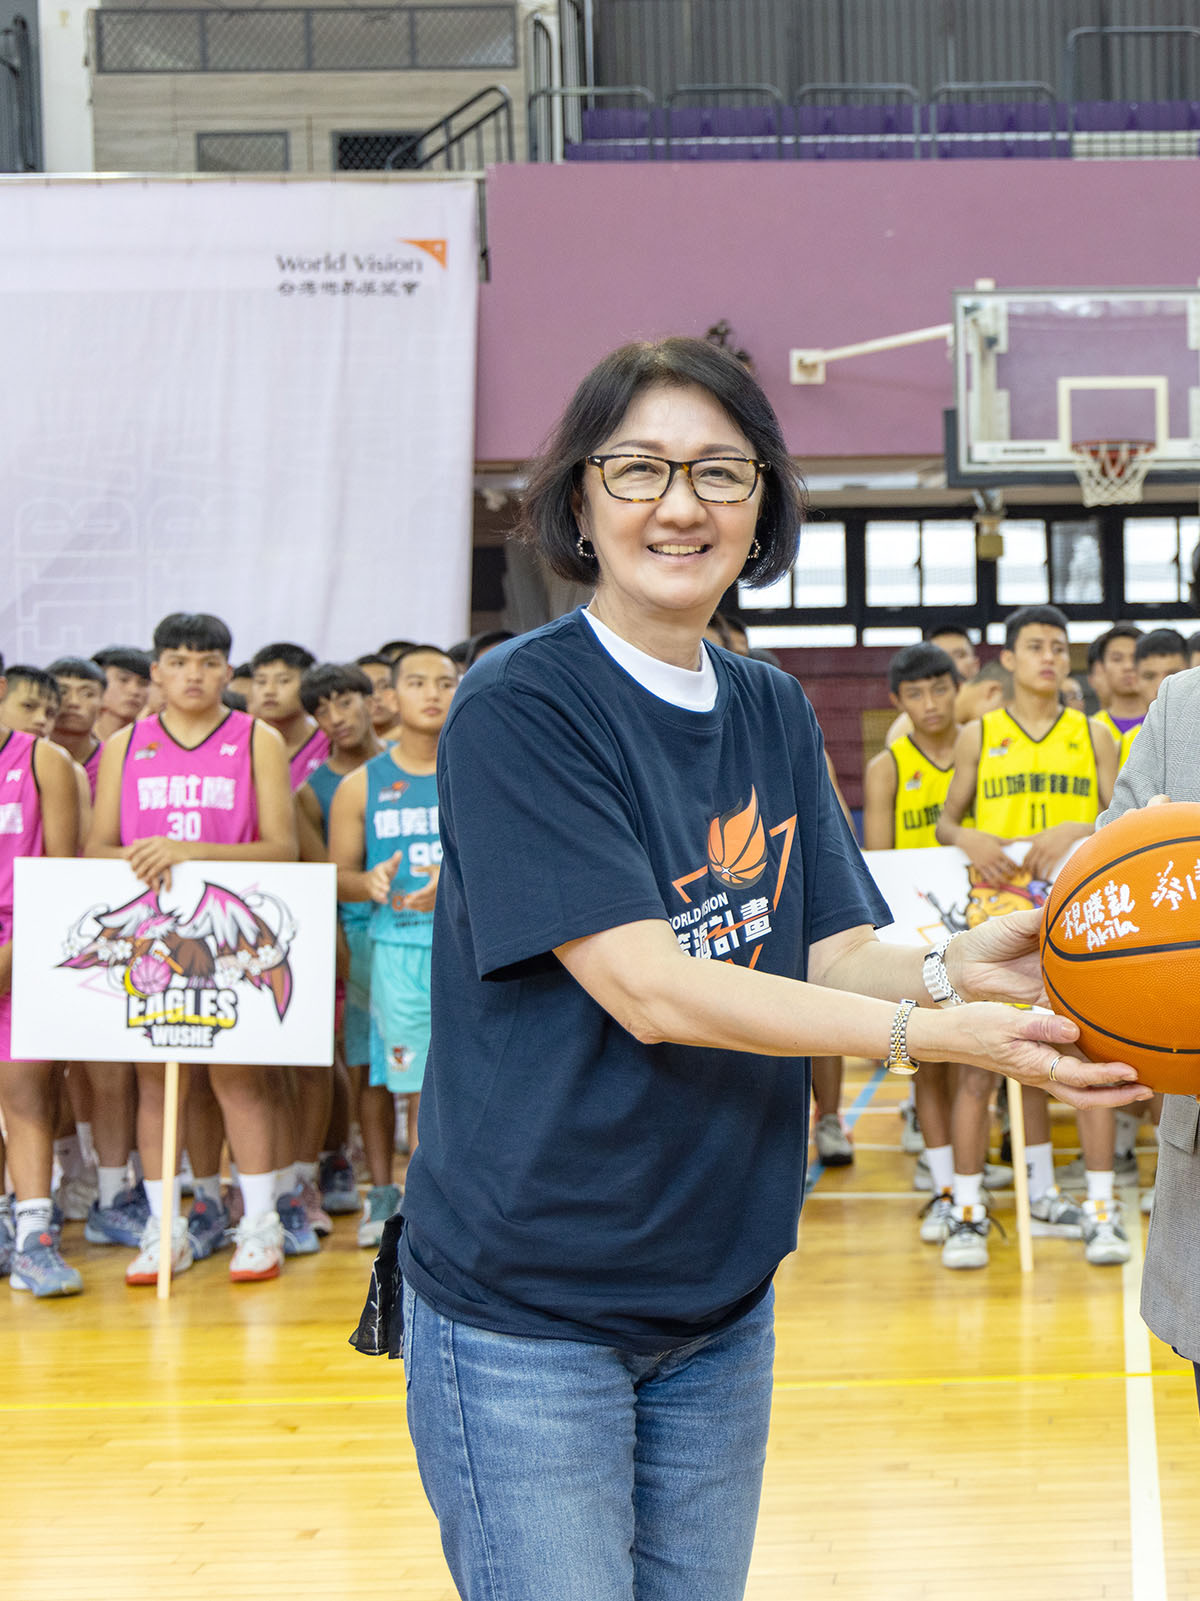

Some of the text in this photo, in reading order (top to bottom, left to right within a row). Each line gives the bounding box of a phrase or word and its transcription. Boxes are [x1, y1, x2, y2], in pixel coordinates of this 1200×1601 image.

[276, 252, 424, 273] World Vision
[167, 811, 201, 841] 30
[1031, 803, 1047, 830] 11
[669, 907, 702, 931] ORLD
[1086, 917, 1140, 952] Akila
[128, 988, 238, 1028] EAGLES
[151, 1024, 214, 1047] WUSHE
